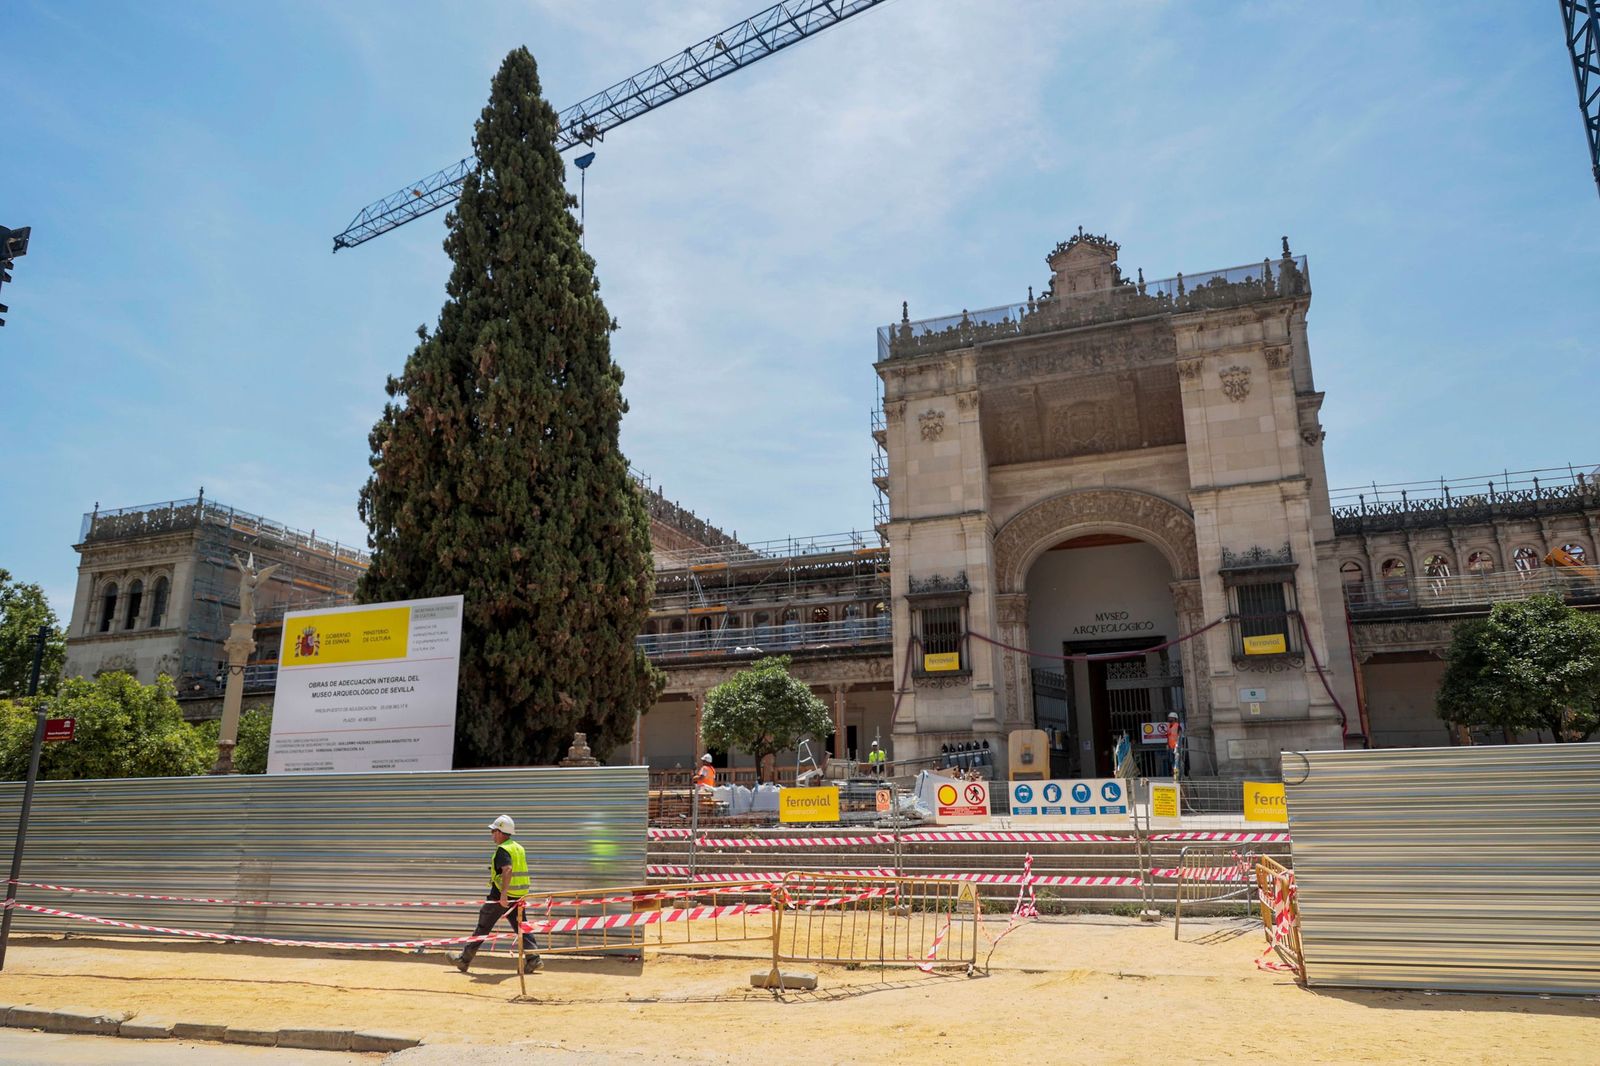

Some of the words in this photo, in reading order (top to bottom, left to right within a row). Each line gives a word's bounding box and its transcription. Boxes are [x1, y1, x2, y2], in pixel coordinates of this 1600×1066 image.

[1095, 611, 1129, 621] MVSEO
[1073, 621, 1154, 635] ARQVEOLOGICO
[325, 632, 351, 640] GOBIERNO
[308, 681, 329, 689] OBRAS
[338, 677, 376, 686] ADECUACIÓN
[377, 676, 406, 684] INTEGRAL
[333, 688, 379, 697] ARQUEOLÓGICO
[390, 685, 415, 694] SEVILLA
[786, 794, 831, 807] ferrovial
